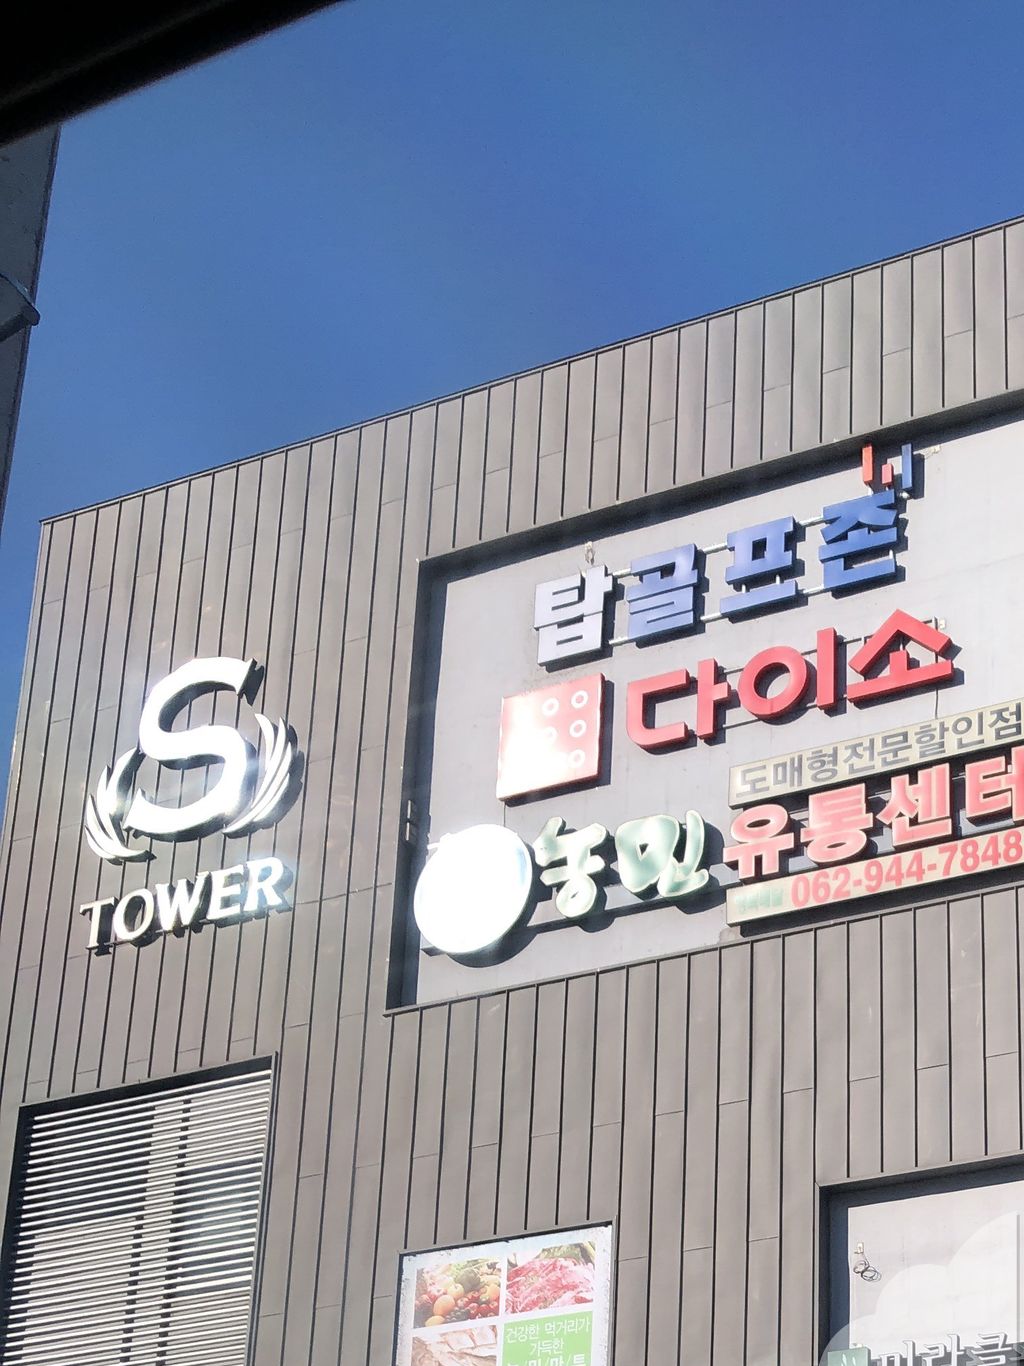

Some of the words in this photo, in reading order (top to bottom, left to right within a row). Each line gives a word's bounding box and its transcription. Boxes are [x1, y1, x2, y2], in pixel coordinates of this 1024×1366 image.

[534, 489, 898, 666] 탑골프존
[626, 608, 954, 749] 다이소
[122, 656, 259, 838] S
[736, 702, 1022, 797] 도매형전문할인점
[80, 857, 285, 950] TOWER
[533, 809, 709, 918] 농민
[791, 829, 1023, 908] 062-944-7848
[506, 1323, 540, 1344] 건강한
[544, 1317, 590, 1336] 먹거리가
[530, 1338, 564, 1357] 가득한
